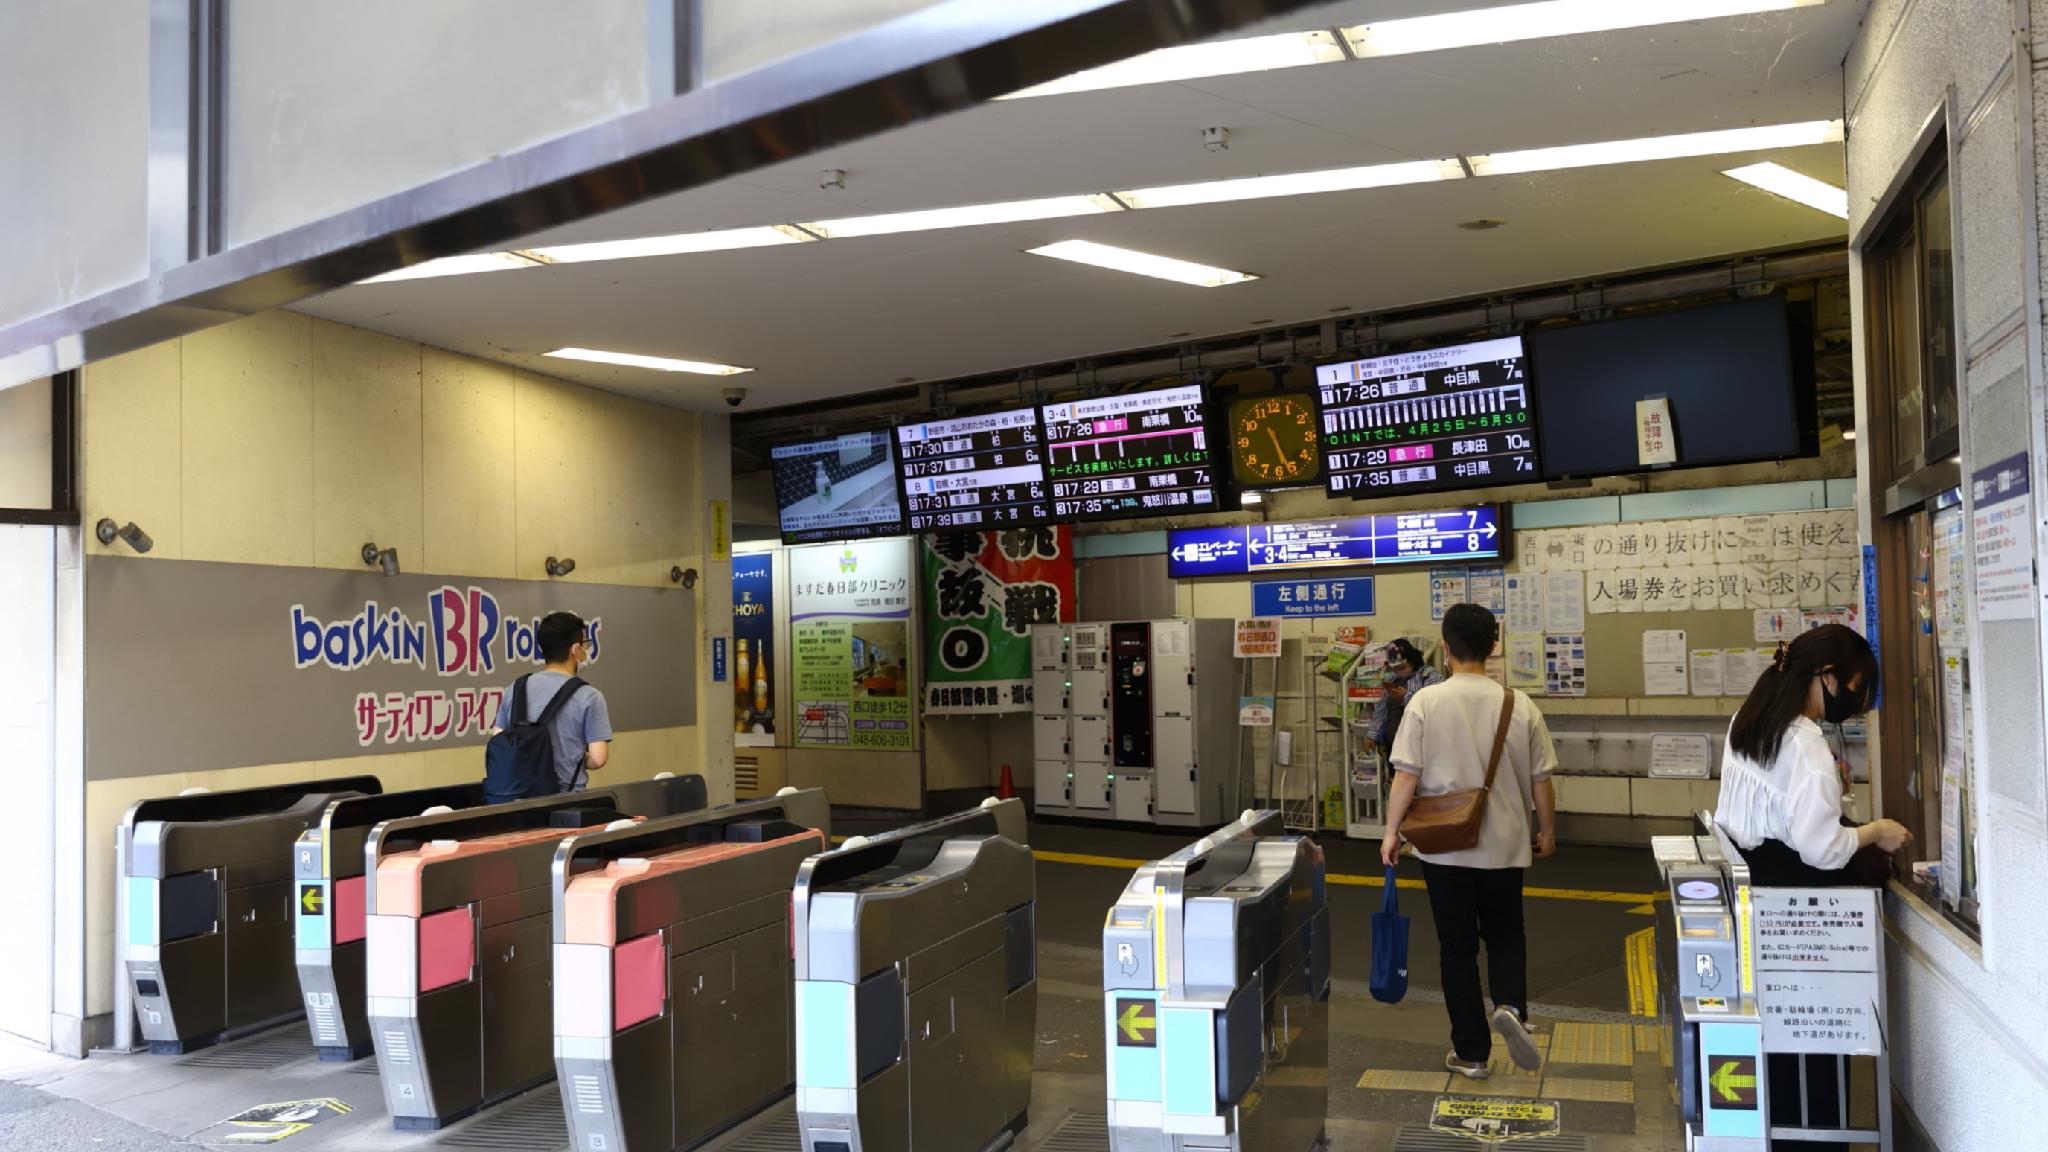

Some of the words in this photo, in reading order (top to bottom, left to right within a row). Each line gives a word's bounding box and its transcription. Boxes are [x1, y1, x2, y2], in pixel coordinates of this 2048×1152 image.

[1336, 384, 1380, 403] 17:26
[1388, 381, 1419, 394] 普通
[1444, 370, 1480, 387] 中目黒
[1268, 402, 1280, 413] 12
[1286, 405, 1291, 415] 1
[1255, 409, 1266, 419] 11
[1296, 414, 1305, 424] 2
[1058, 422, 1092, 438] 17:26
[1142, 413, 1171, 428] 南栗橋
[1245, 420, 1257, 431] 10
[1241, 437, 1249, 448] 9
[1305, 431, 1313, 442] 3
[912, 444, 941, 457] 17:30
[1300, 449, 1309, 460] 4
[1342, 450, 1387, 468] 17:29
[1395, 445, 1427, 460] 急行
[1452, 439, 1488, 456] 長津田
[1248, 454, 1257, 465] 8
[914, 461, 944, 476] 17:37
[1261, 464, 1269, 474] 7
[1276, 466, 1283, 477] 6
[1288, 461, 1297, 473] 5
[1345, 471, 1390, 489] 17:35
[1398, 468, 1430, 480] 普通
[1454, 460, 1490, 476] 中目黒
[914, 482, 921, 492] 8
[1065, 480, 1100, 496] 17:29
[1107, 478, 1130, 491] 普通
[1149, 473, 1178, 487] 南栗橋
[918, 496, 947, 510] 17:31
[991, 489, 1015, 502] 大宮
[1067, 499, 1101, 515] 17:35
[921, 514, 951, 529] 17:39
[994, 508, 1018, 521] 大宮
[1467, 511, 1478, 529] 7
[1199, 541, 1242, 552] エレベーター
[1468, 533, 1479, 551] 8
[1594, 529, 1738, 561] の通り抜けに
[1772, 521, 1850, 547] は使え
[795, 577, 906, 597] ますだ春日部クリニック
[1278, 582, 1346, 602] 左側通行
[1285, 604, 1304, 613] Keep
[1305, 603, 1313, 612] to
[1315, 602, 1326, 611] the
[1327, 602, 1340, 611] left
[294, 605, 425, 667] baskin
[429, 588, 499, 673] BR
[853, 700, 907, 714] 西口徒歩12分
[357, 694, 452, 741] サーティワン
[1789, 897, 1838, 906] お願い
[1784, 1018, 1852, 1026] 線路沿いの道路に
[1792, 1031, 1866, 1040] 地下道があります。
